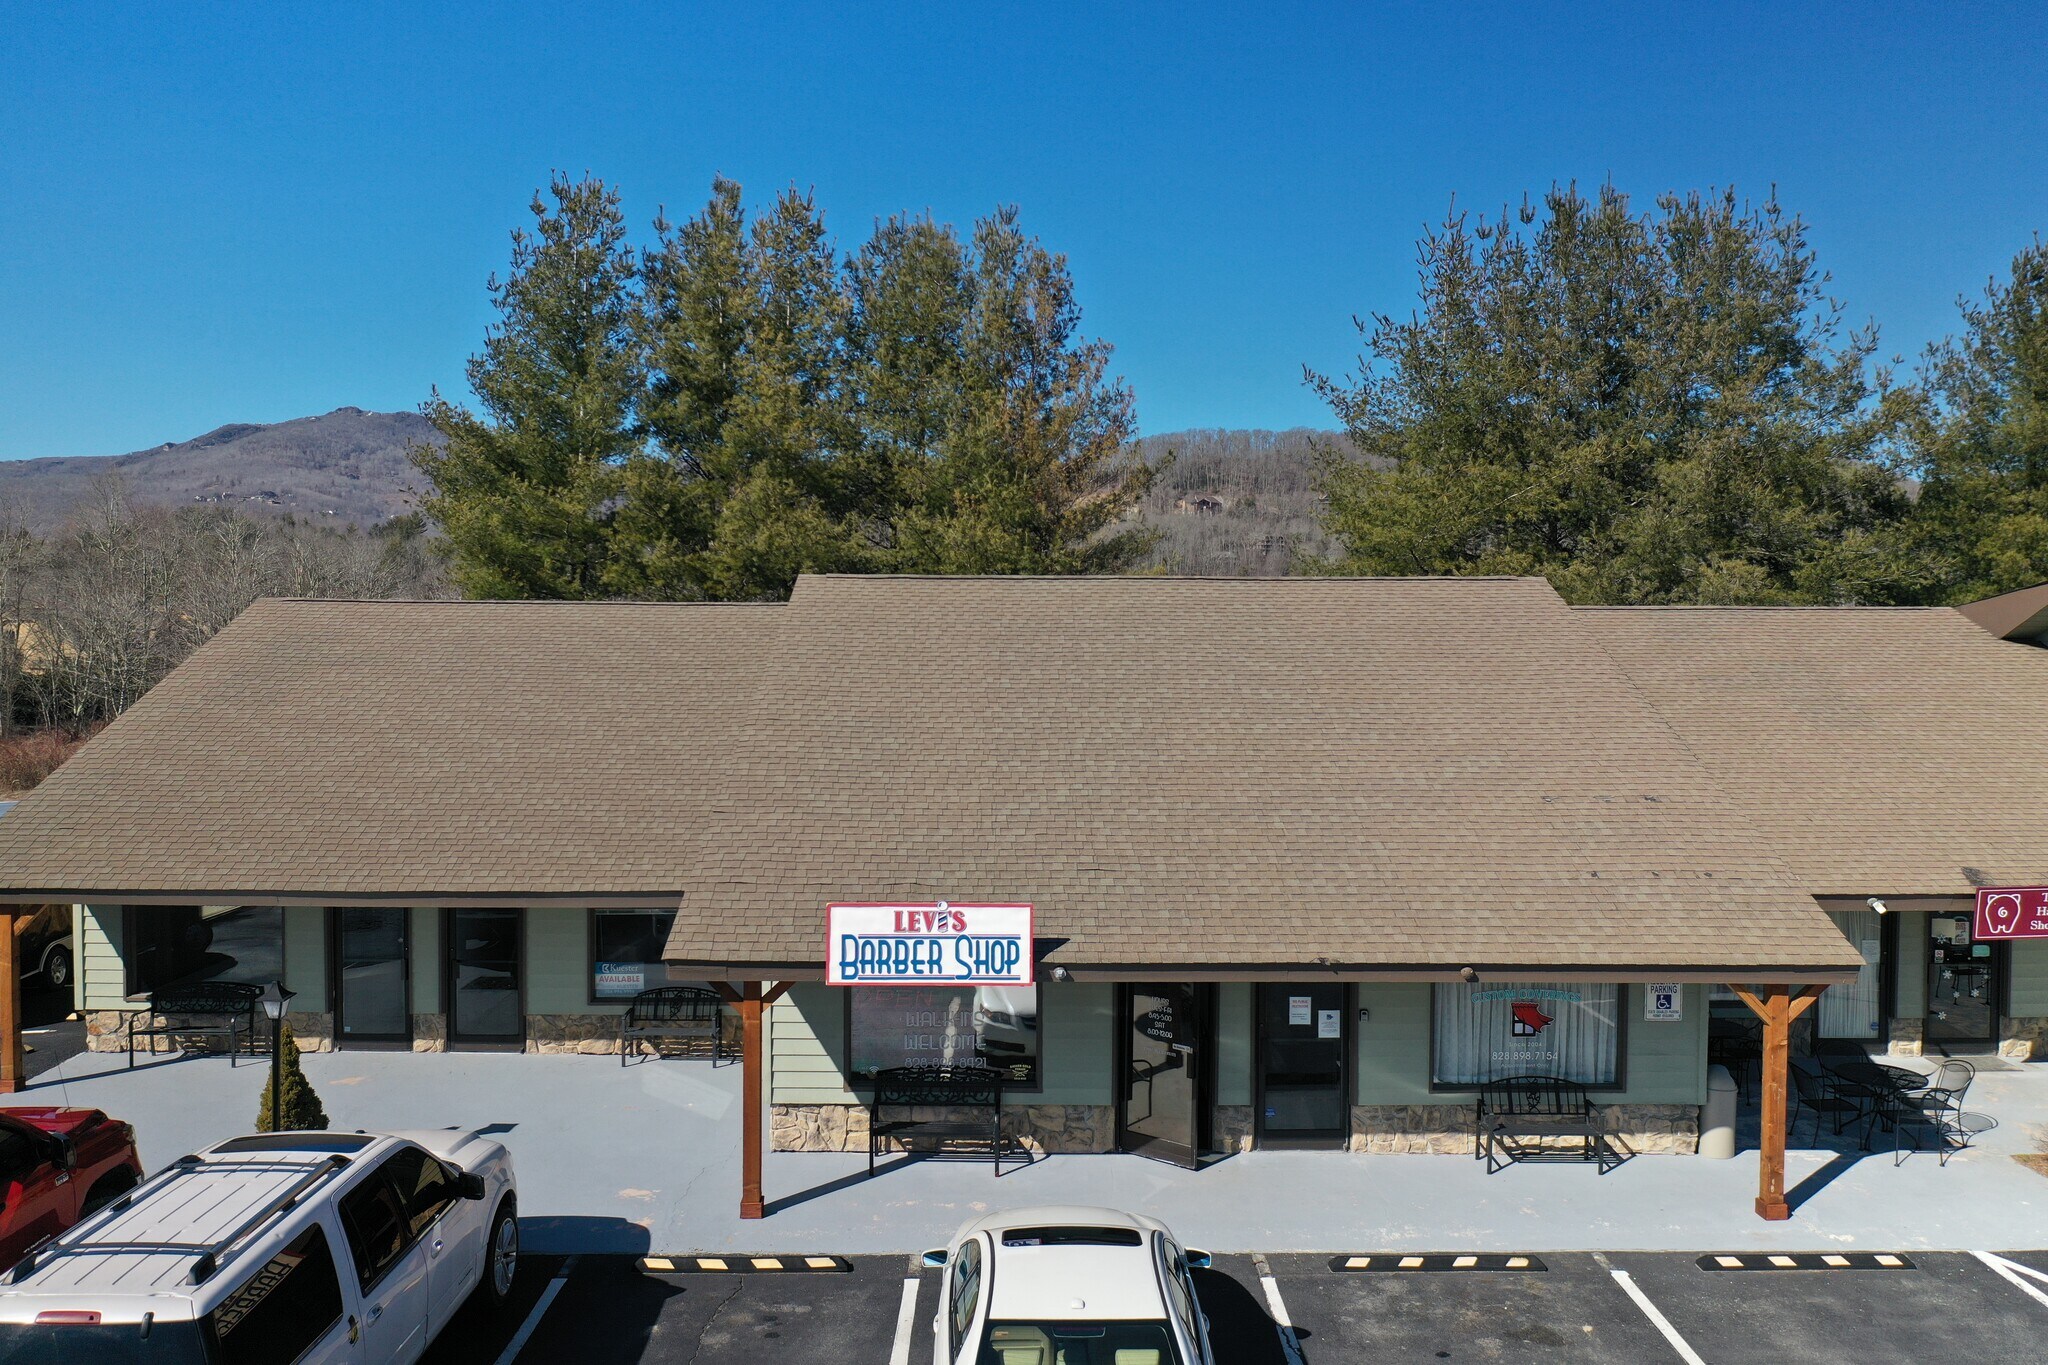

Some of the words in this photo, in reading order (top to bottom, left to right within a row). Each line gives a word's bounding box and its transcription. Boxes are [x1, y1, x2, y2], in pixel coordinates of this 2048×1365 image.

[893, 909, 968, 933] LEVI'S
[839, 934, 943, 980] BARBER
[953, 934, 1020, 980] SHOP
[610, 964, 638, 972] Kuester
[599, 975, 640, 983] AVAILABLE
[1471, 989, 1517, 1004] CUSTOM
[1519, 988, 1582, 1003] COVERINGS
[1650, 985, 1678, 994] PARKING
[905, 1011, 985, 1028] WALK-INS
[904, 1034, 986, 1050] WELCOME
[1492, 1051, 1558, 1060] 828.898.7154
